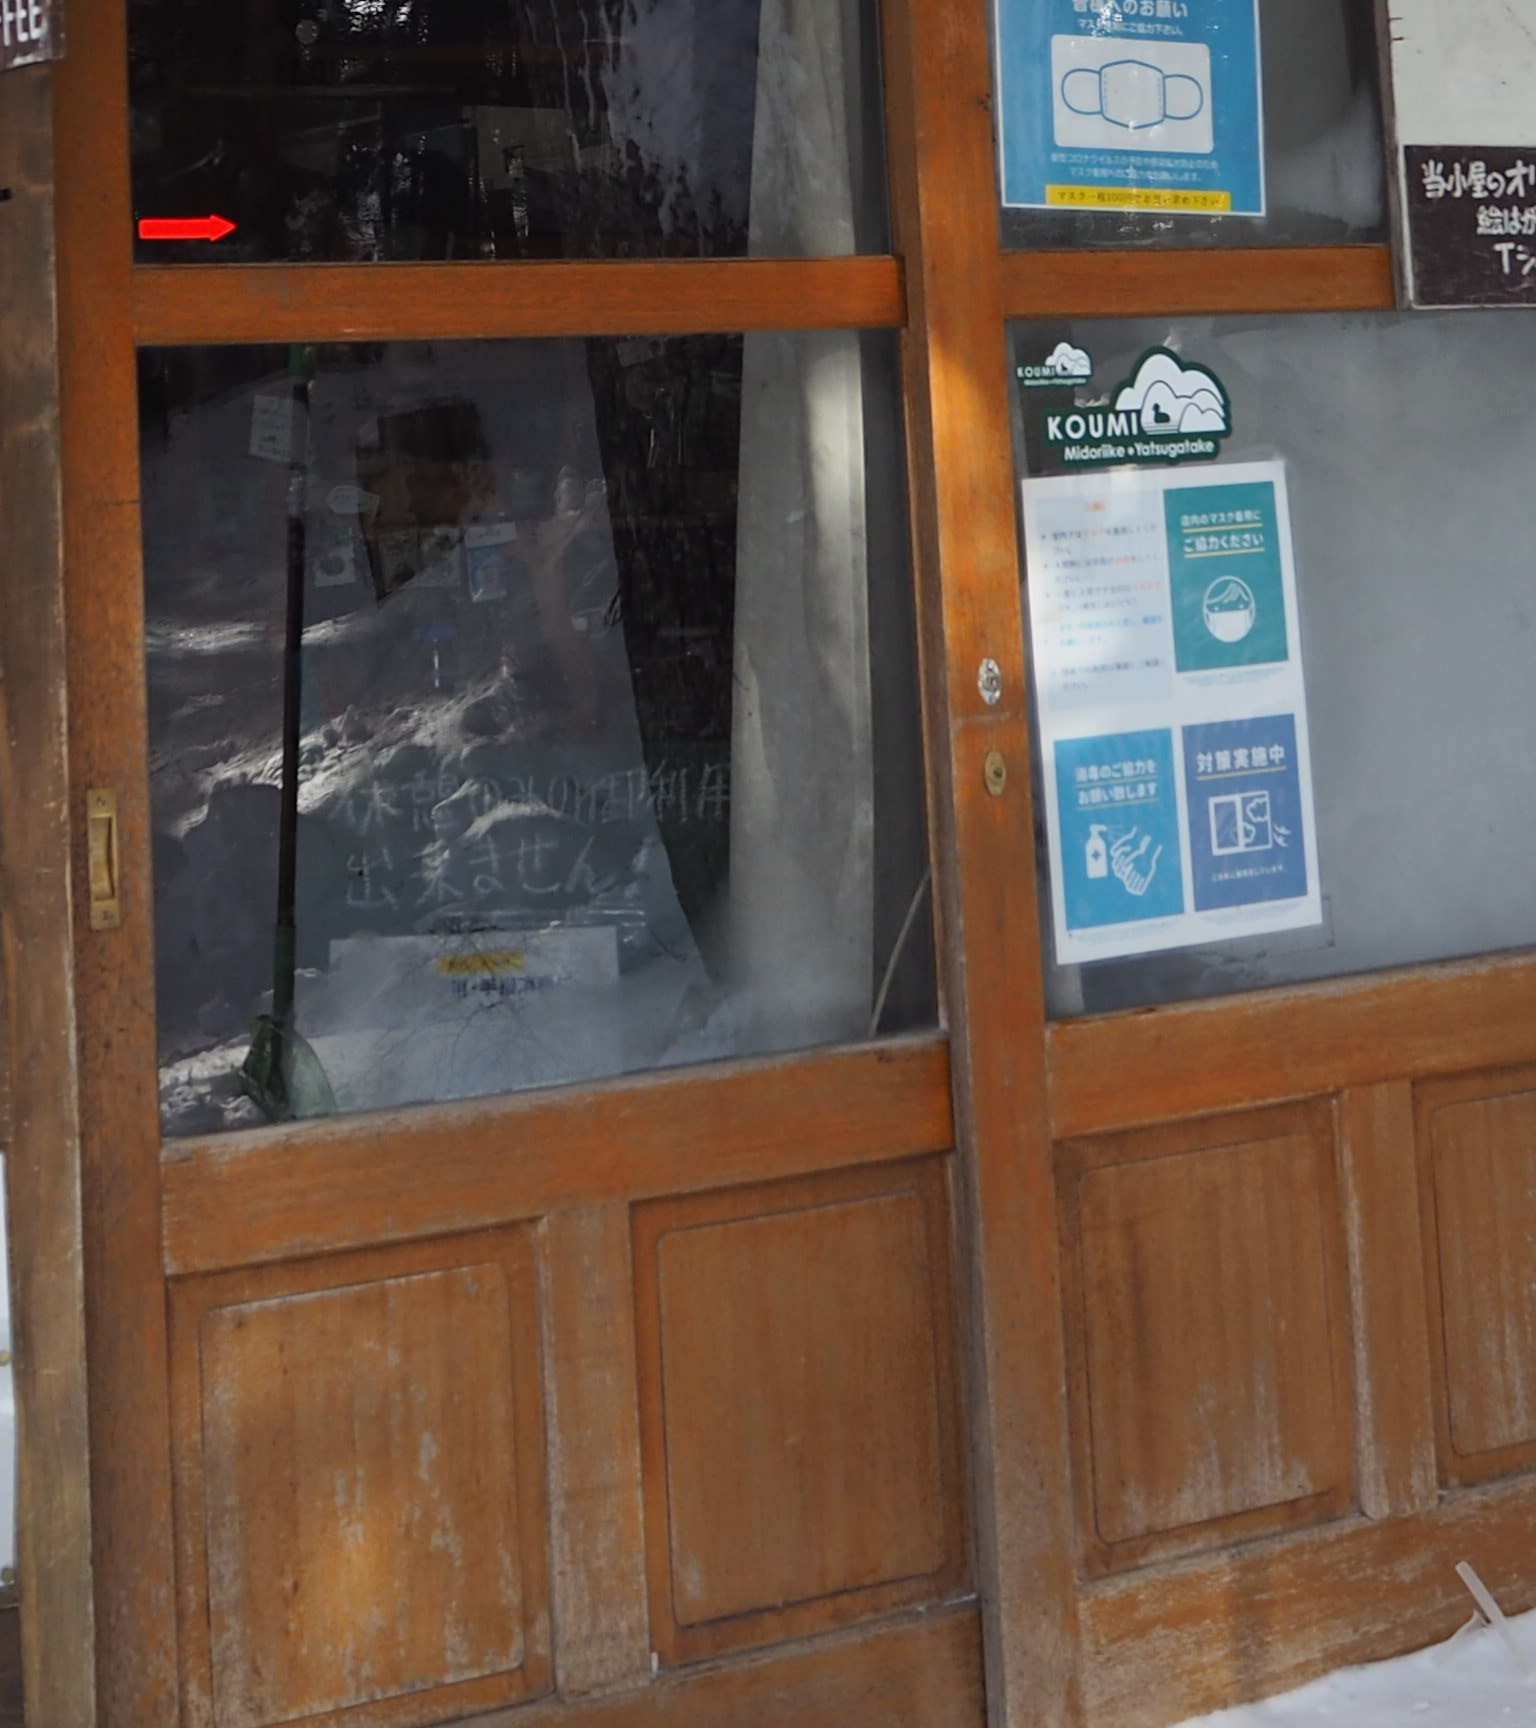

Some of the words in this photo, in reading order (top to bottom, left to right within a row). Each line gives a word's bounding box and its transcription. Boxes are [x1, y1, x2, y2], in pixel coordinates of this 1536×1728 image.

[1017, 366, 1055, 378] KOUMI
[1047, 413, 1138, 441] KOUMI
[1064, 443, 1125, 462] Midoriike
[1134, 438, 1214, 460] Yatsugatake
[1183, 532, 1265, 553] ご協力ください
[1196, 744, 1286, 773] 対策実施中
